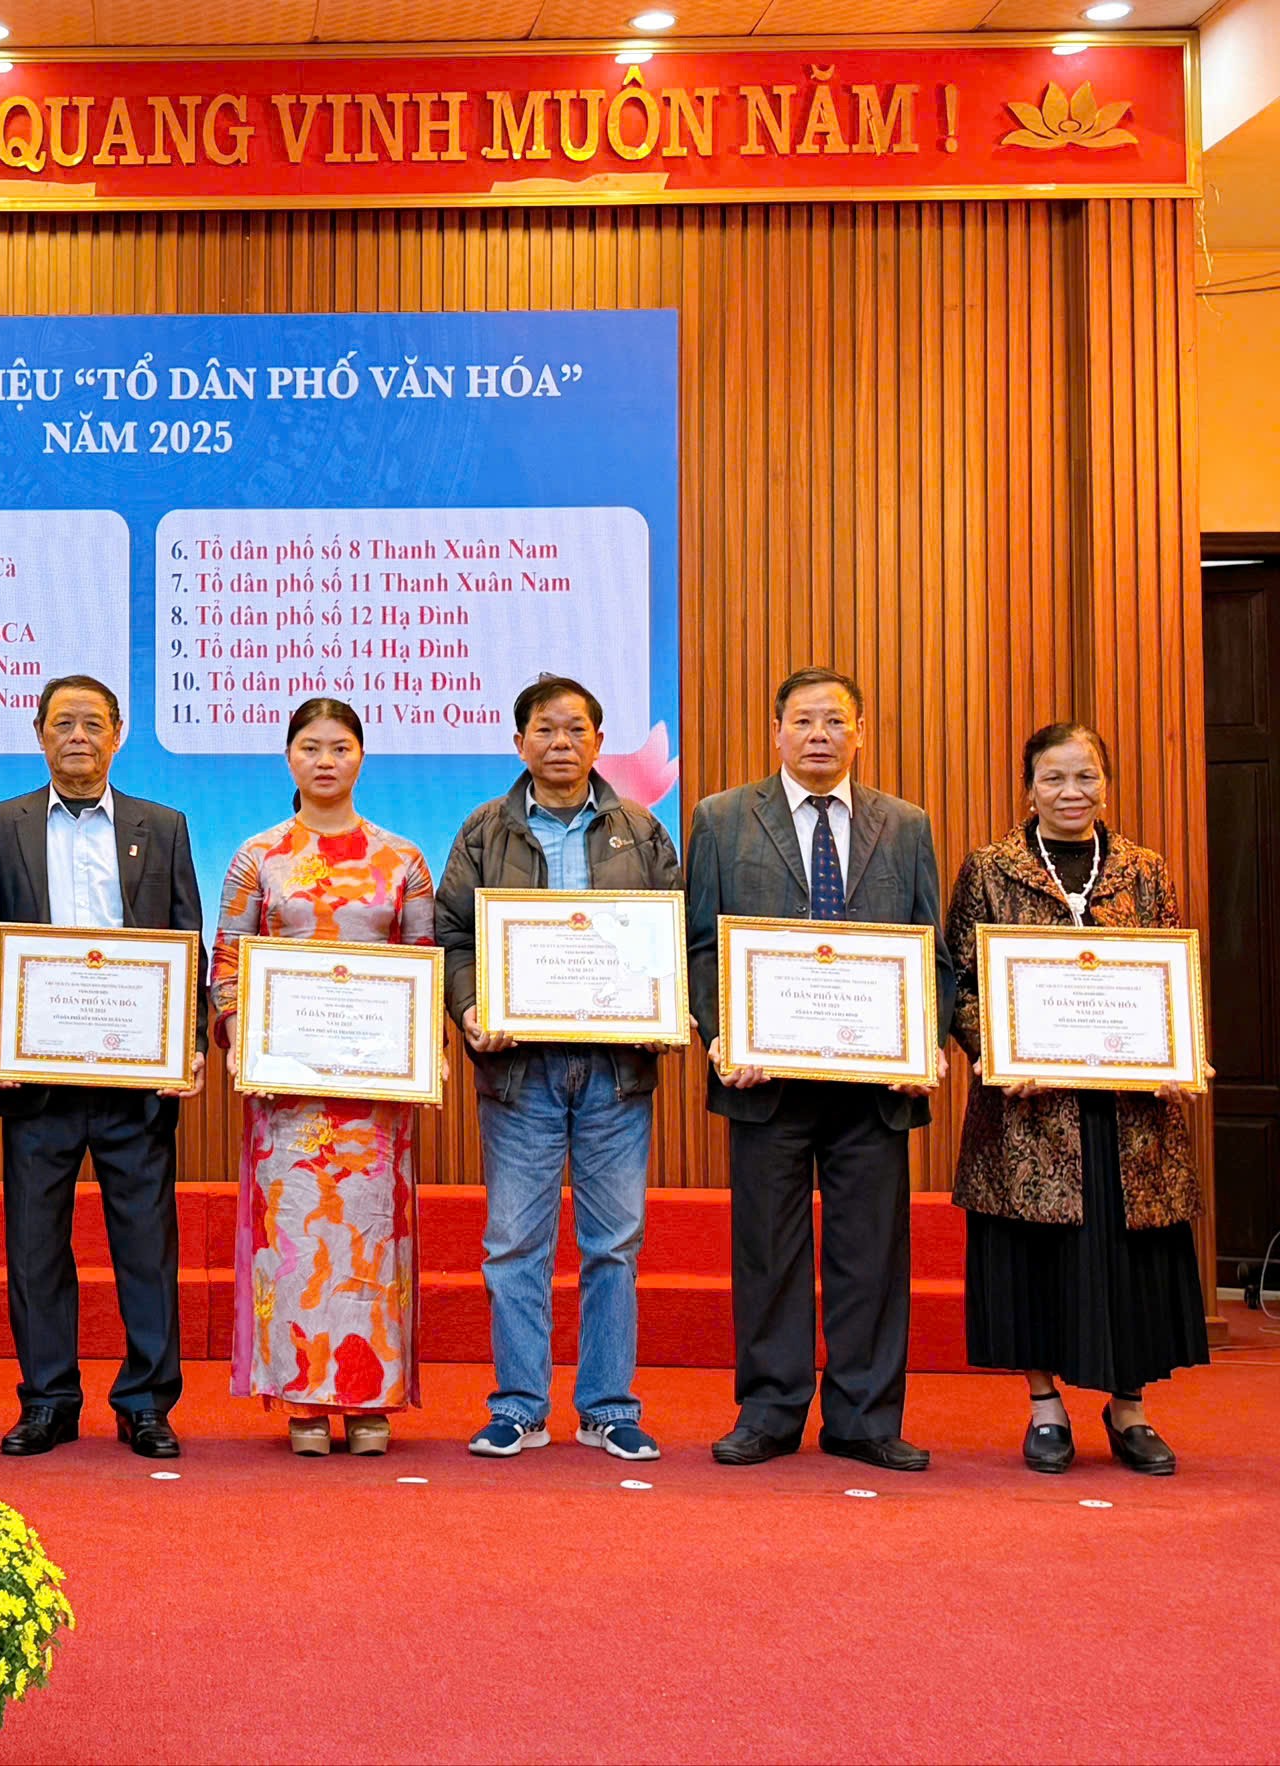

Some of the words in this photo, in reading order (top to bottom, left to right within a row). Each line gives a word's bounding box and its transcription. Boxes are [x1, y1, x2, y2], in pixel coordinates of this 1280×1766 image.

[276, 91, 468, 166] VINH
[480, 65, 721, 162] MUÔN
[738, 64, 920, 156] NĂM
[169, 357, 256, 399] DÂN
[267, 351, 359, 399] PHỐ
[369, 355, 455, 399] VĂN
[43, 410, 137, 453] NĂM
[149, 420, 233, 454] 2025
[171, 540, 188, 560] 6.
[195, 534, 223, 560] Tổ
[230, 540, 268, 560] dân
[276, 534, 314, 564] phố
[321, 534, 342, 560] số
[349, 540, 361, 560] 8
[368, 540, 436, 560] Thanh
[444, 539, 500, 559] Xuân
[508, 539, 558, 559] Nam
[171, 573, 188, 593] 7.
[195, 567, 223, 593] Tổ
[230, 573, 268, 593] dân
[276, 567, 314, 598] phố
[321, 567, 342, 593] số
[350, 573, 370, 592] 11
[380, 573, 448, 592] Thanh
[456, 572, 513, 592] Xuân
[520, 572, 570, 592] Nam
[171, 606, 188, 626] 8.
[195, 600, 223, 626] Tổ
[230, 606, 268, 626] dân
[276, 600, 314, 630] phố
[321, 600, 342, 626] số
[350, 606, 373, 625] 12
[381, 606, 410, 630] Hạ
[418, 605, 469, 625] Đình
[171, 639, 188, 659] 9.
[195, 633, 223, 659] Tổ
[230, 638, 268, 659] dân
[276, 633, 314, 663] phố
[321, 633, 342, 659] số
[350, 639, 373, 658] 14
[381, 639, 410, 663] Hạ
[418, 638, 469, 658] Đình
[172, 672, 200, 691] 10.
[208, 666, 235, 691] Tổ
[242, 671, 280, 691] dân
[288, 666, 326, 696] phố
[334, 666, 354, 691] số
[363, 672, 385, 691] 16
[392, 672, 422, 696] Hạ
[431, 671, 481, 691] Đình
[172, 705, 200, 724] 11.
[208, 698, 235, 724] Tổ
[242, 704, 280, 724] dân
[364, 705, 383, 724] 11
[392, 704, 435, 724] Văn
[443, 703, 500, 728] Quán
